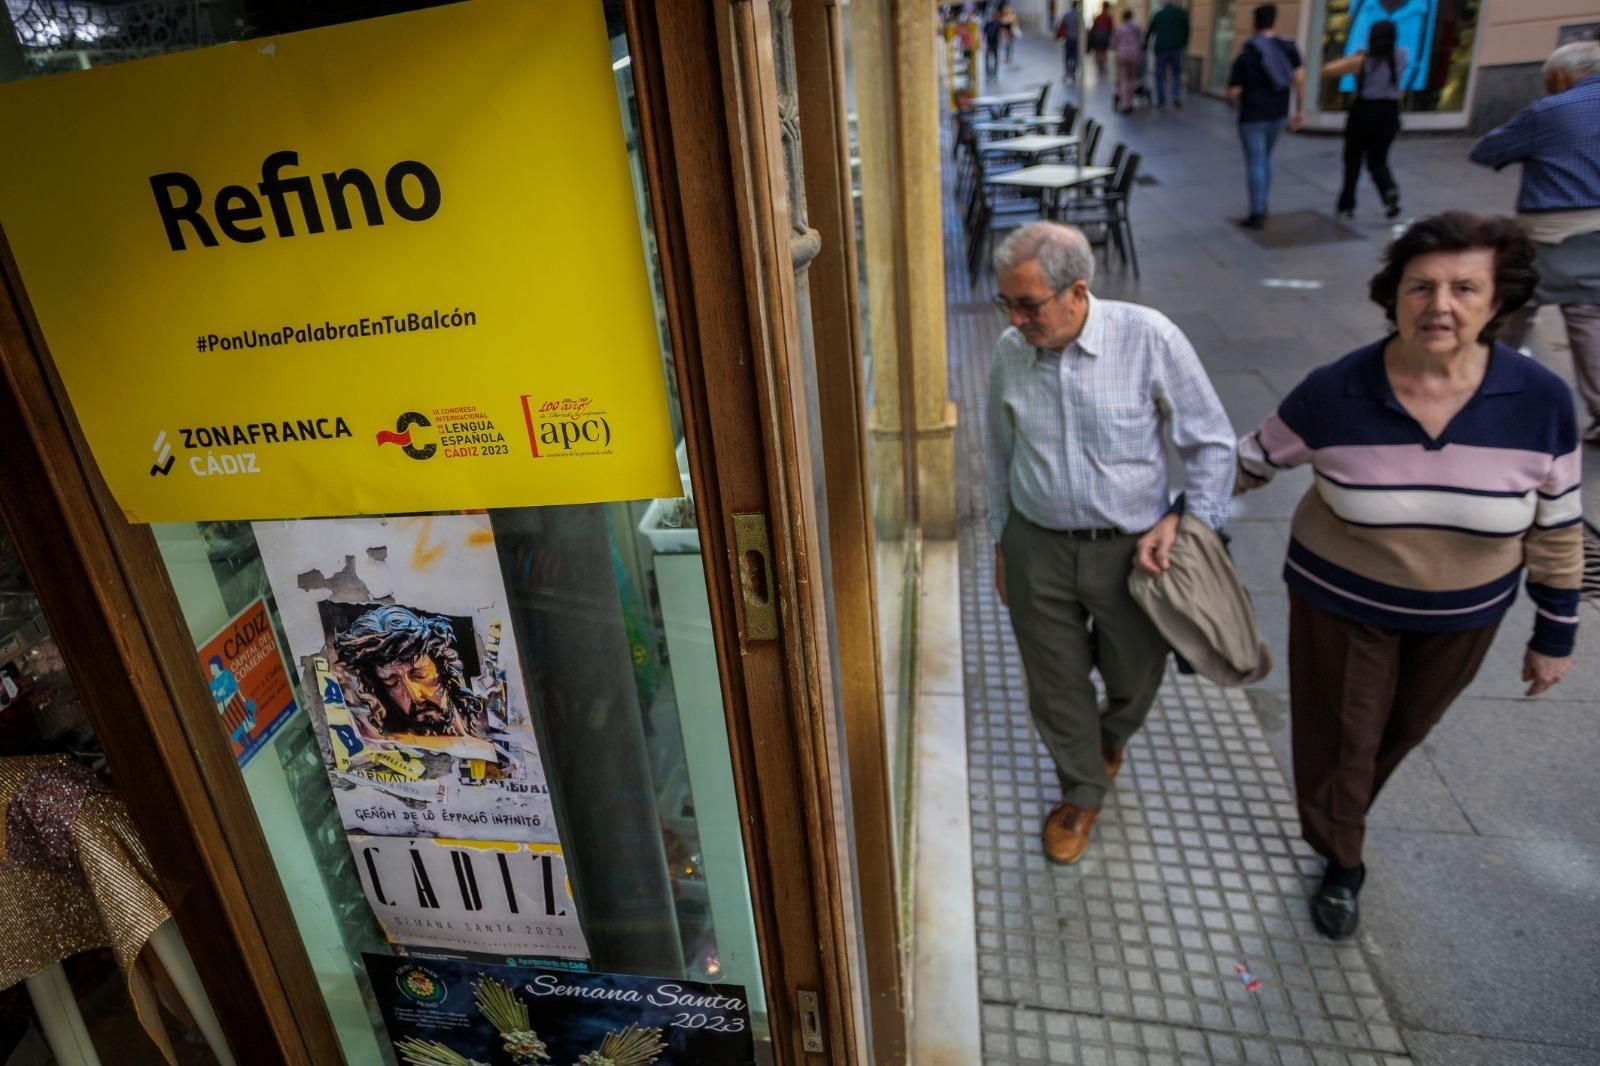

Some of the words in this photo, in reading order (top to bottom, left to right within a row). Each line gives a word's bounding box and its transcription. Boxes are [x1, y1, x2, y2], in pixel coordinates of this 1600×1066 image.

[149, 151, 441, 251] Refino
[196, 308, 476, 352] #PonUnaPalabraEnTuBalcón
[435, 412, 488, 422] INTERNACIONAL
[441, 406, 476, 415] CONGRESO
[179, 417, 352, 448] ZONAFRANCA
[441, 431, 505, 446] ESPAÑOLA
[445, 421, 495, 434] LENGUA
[190, 451, 261, 476] CÁDIZ
[444, 446, 479, 459] CÁDIZ
[481, 444, 509, 456] 2023
[224, 612, 270, 660] CÁDIZ
[230, 644, 258, 673] CAPITAL
[259, 632, 272, 646] DEL
[234, 641, 276, 683] COMERCIO
[403, 812, 418, 820] DE
[363, 841, 566, 916] CÁDIZ
[394, 916, 454, 931] SEMANA
[465, 922, 513, 934] SANTA
[526, 925, 564, 936] 2023
[525, 974, 644, 1002] Semana
[646, 984, 747, 1011] Santa
[670, 1013, 745, 1032] 2023
